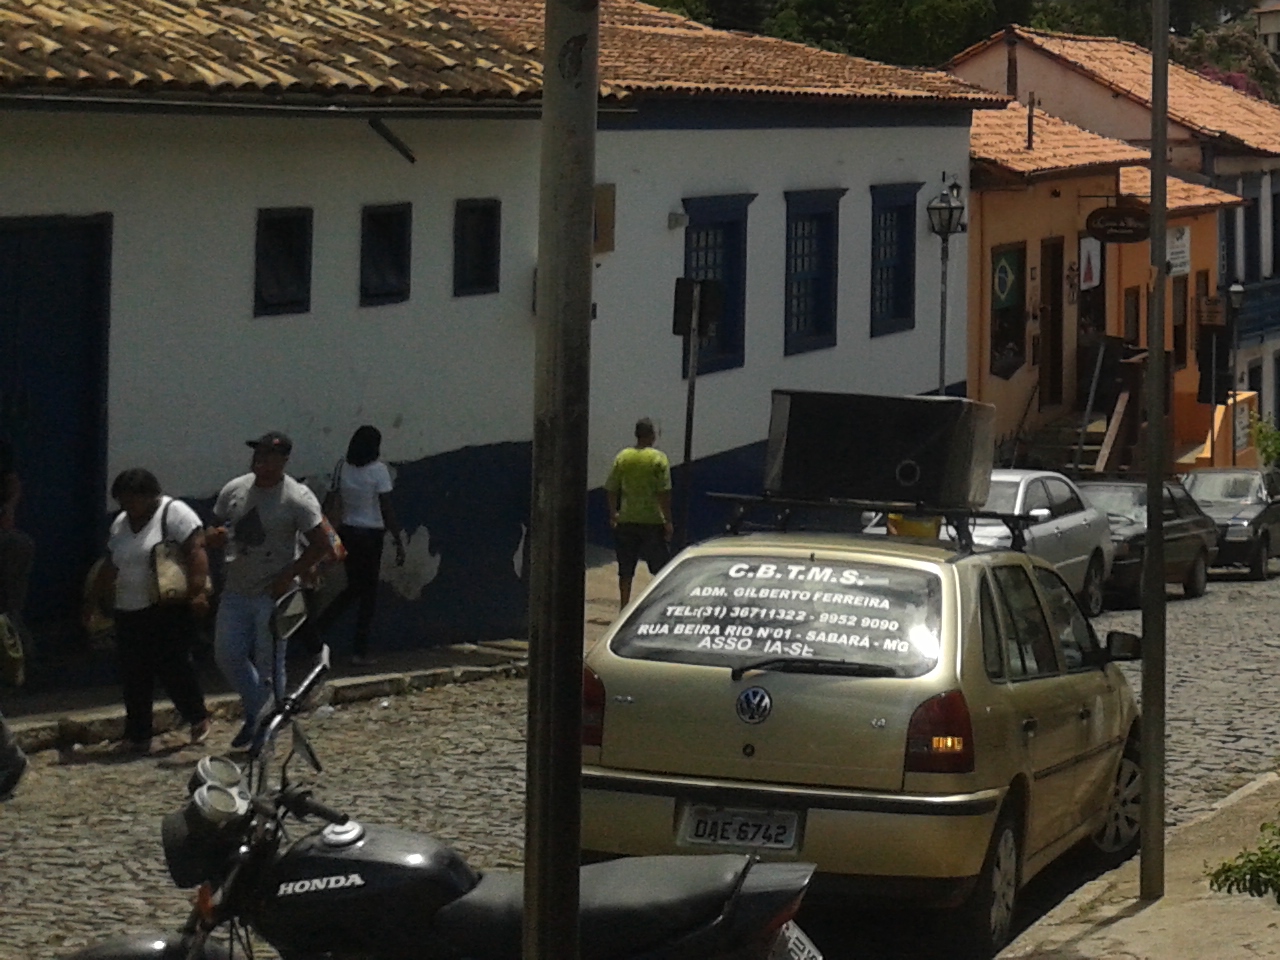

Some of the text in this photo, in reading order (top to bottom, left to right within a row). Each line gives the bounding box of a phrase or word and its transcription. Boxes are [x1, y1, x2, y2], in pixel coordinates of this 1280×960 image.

[729, 563, 864, 586] C.B.T.M.S.
[690, 587, 890, 610] ADM. GILBERTO FERREIRA
[730, 606, 806, 621] 36711322
[819, 612, 857, 626] 9952
[861, 617, 899, 631] 9090
[637, 623, 669, 635] RUA
[673, 624, 720, 636] BEIRA
[724, 625, 753, 637] RIO
[806, 630, 870, 648] SABARÁ
[883, 639, 909, 652] MG
[277, 873, 365, 897] HONDA
